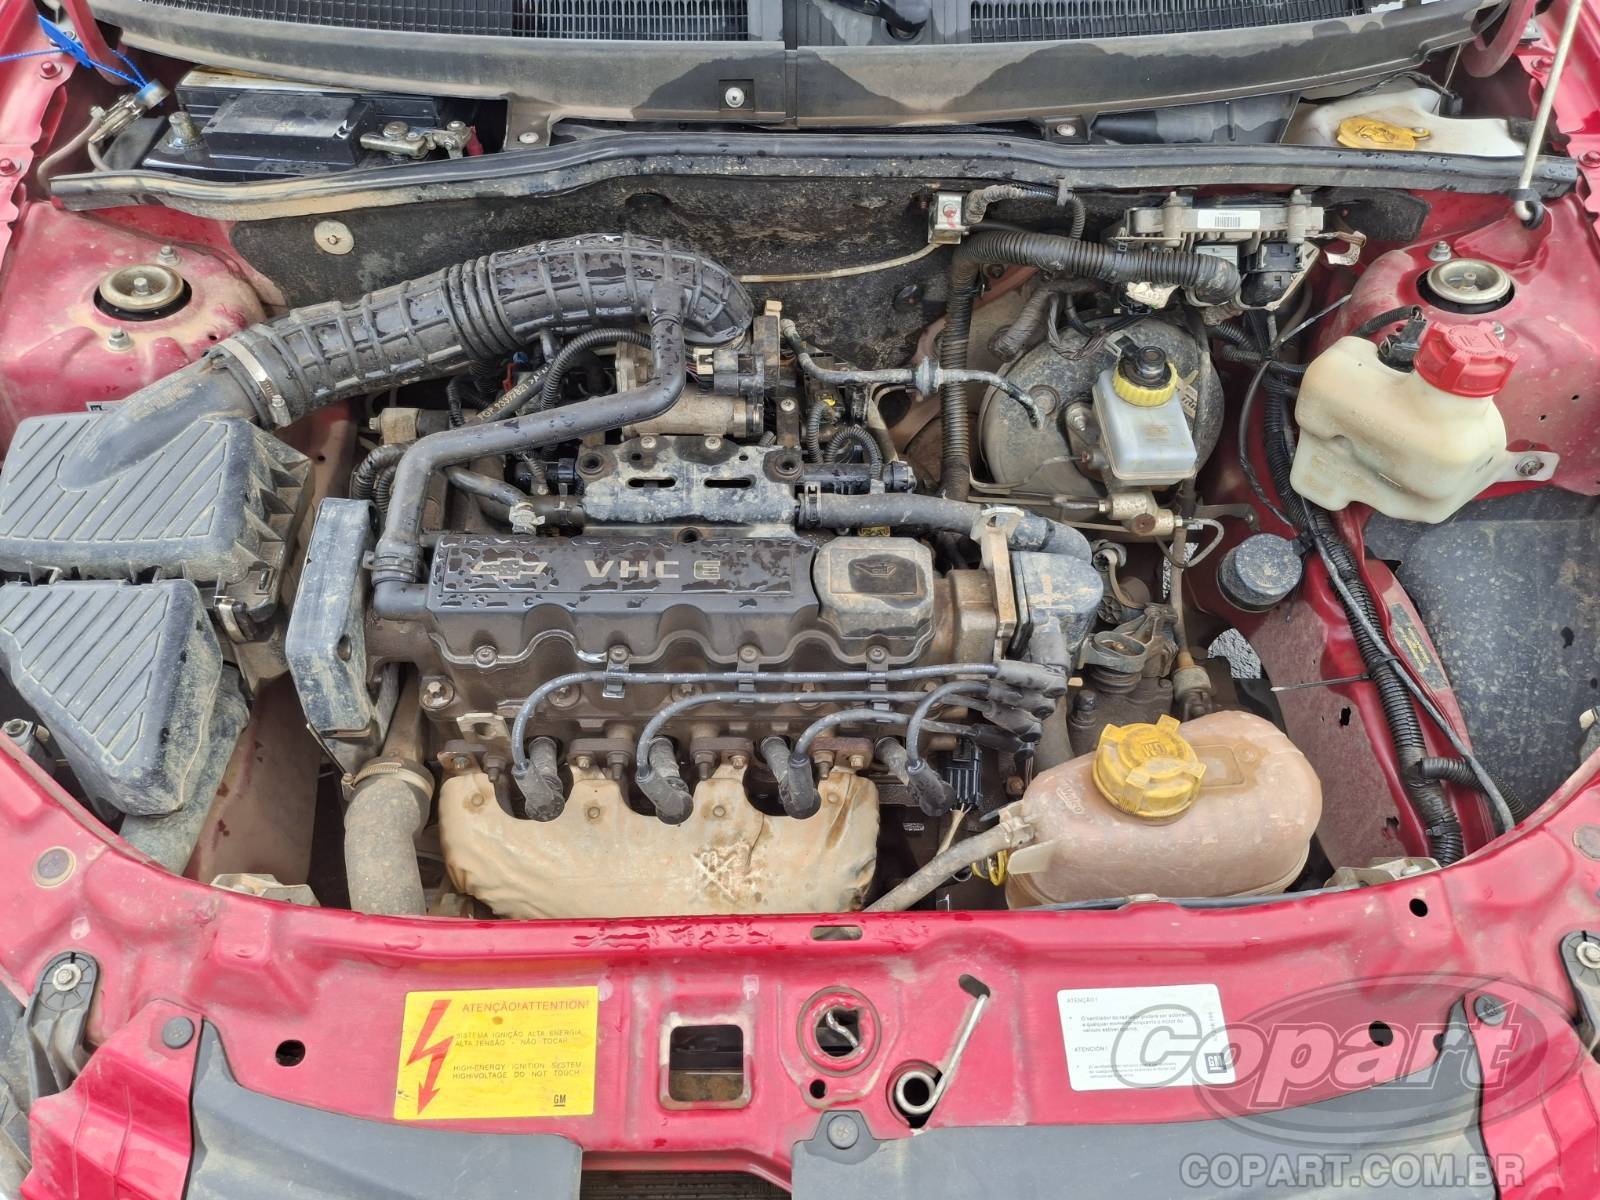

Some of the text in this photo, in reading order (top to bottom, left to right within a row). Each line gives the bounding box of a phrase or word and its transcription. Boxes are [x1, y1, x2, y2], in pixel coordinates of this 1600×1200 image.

[584, 560, 721, 580] VHC E
[455, 1031, 488, 1039] SISTEMA
[492, 1030, 523, 1040] IGNIÇÃO
[549, 1029, 583, 1037] ENERGIA
[476, 1038, 505, 1047] TENSÃO
[520, 1037, 537, 1046] NÃO
[543, 1037, 568, 1045] TOCAR
[453, 1063, 506, 1072] HIGH-ENERGY
[511, 1062, 545, 1070] IGNITION
[513, 1071, 526, 1079] DO
[553, 1069, 581, 1077] TOUCH
[553, 1094, 567, 1106] GM
